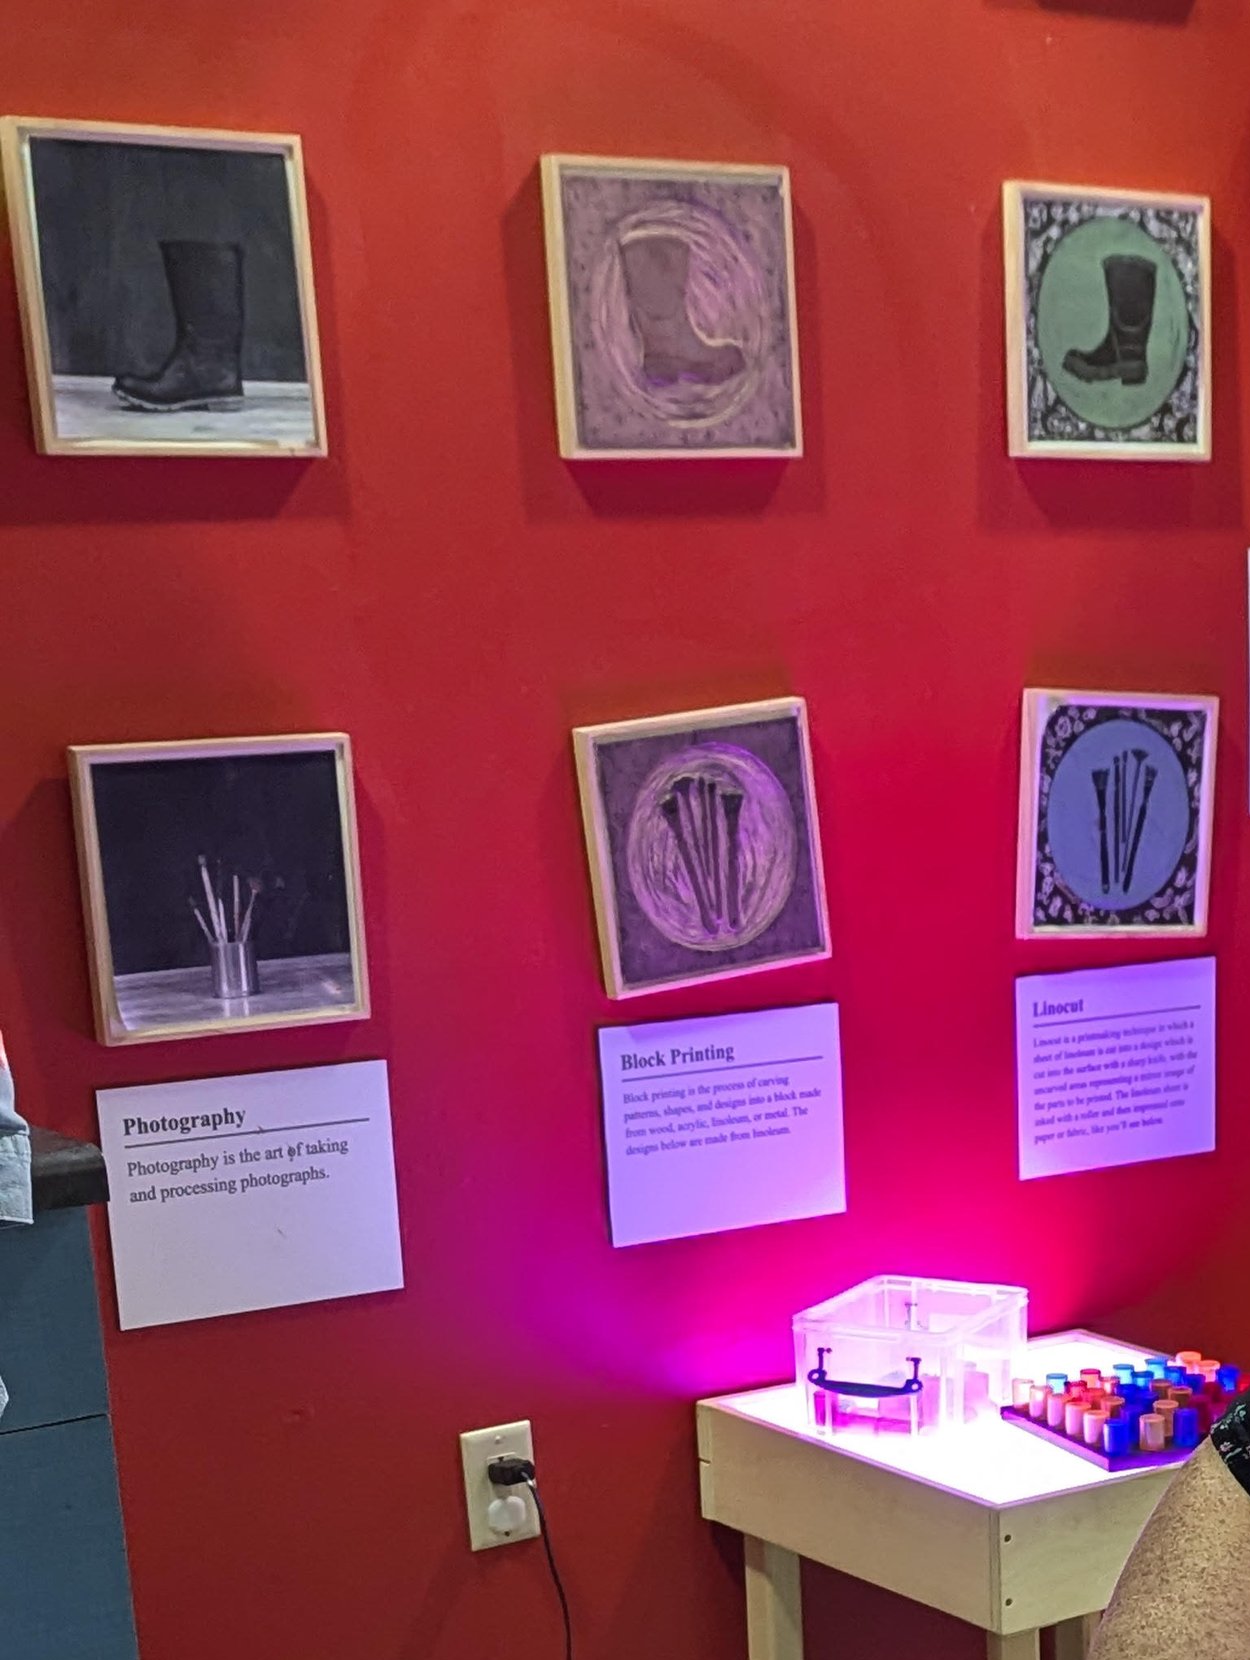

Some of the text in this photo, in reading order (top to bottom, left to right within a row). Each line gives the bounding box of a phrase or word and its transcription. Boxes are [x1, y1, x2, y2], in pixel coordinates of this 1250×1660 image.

[1033, 999, 1083, 1017] Linocut
[621, 1044, 734, 1070] Block Printing
[623, 1091, 649, 1104] Block
[651, 1089, 685, 1102] printing
[697, 1084, 710, 1094] the
[712, 1082, 745, 1095] process
[746, 1077, 757, 1088] of
[757, 1076, 789, 1087] carving
[696, 1101, 713, 1112] and
[714, 1098, 746, 1109] designs
[748, 1096, 765, 1105] into
[773, 1090, 797, 1102] block
[799, 1087, 821, 1098] made
[123, 1107, 246, 1137] Photography
[625, 1127, 646, 1138] from
[753, 1113, 762, 1121] or
[792, 1106, 808, 1116] The
[626, 1144, 659, 1155] designs
[660, 1139, 686, 1150] below
[689, 1138, 703, 1147] are
[704, 1133, 727, 1144] made
[729, 1131, 750, 1141] from
[127, 1139, 349, 1177] Photography is the art of taking
[129, 1166, 330, 1202] and processing photographs.
